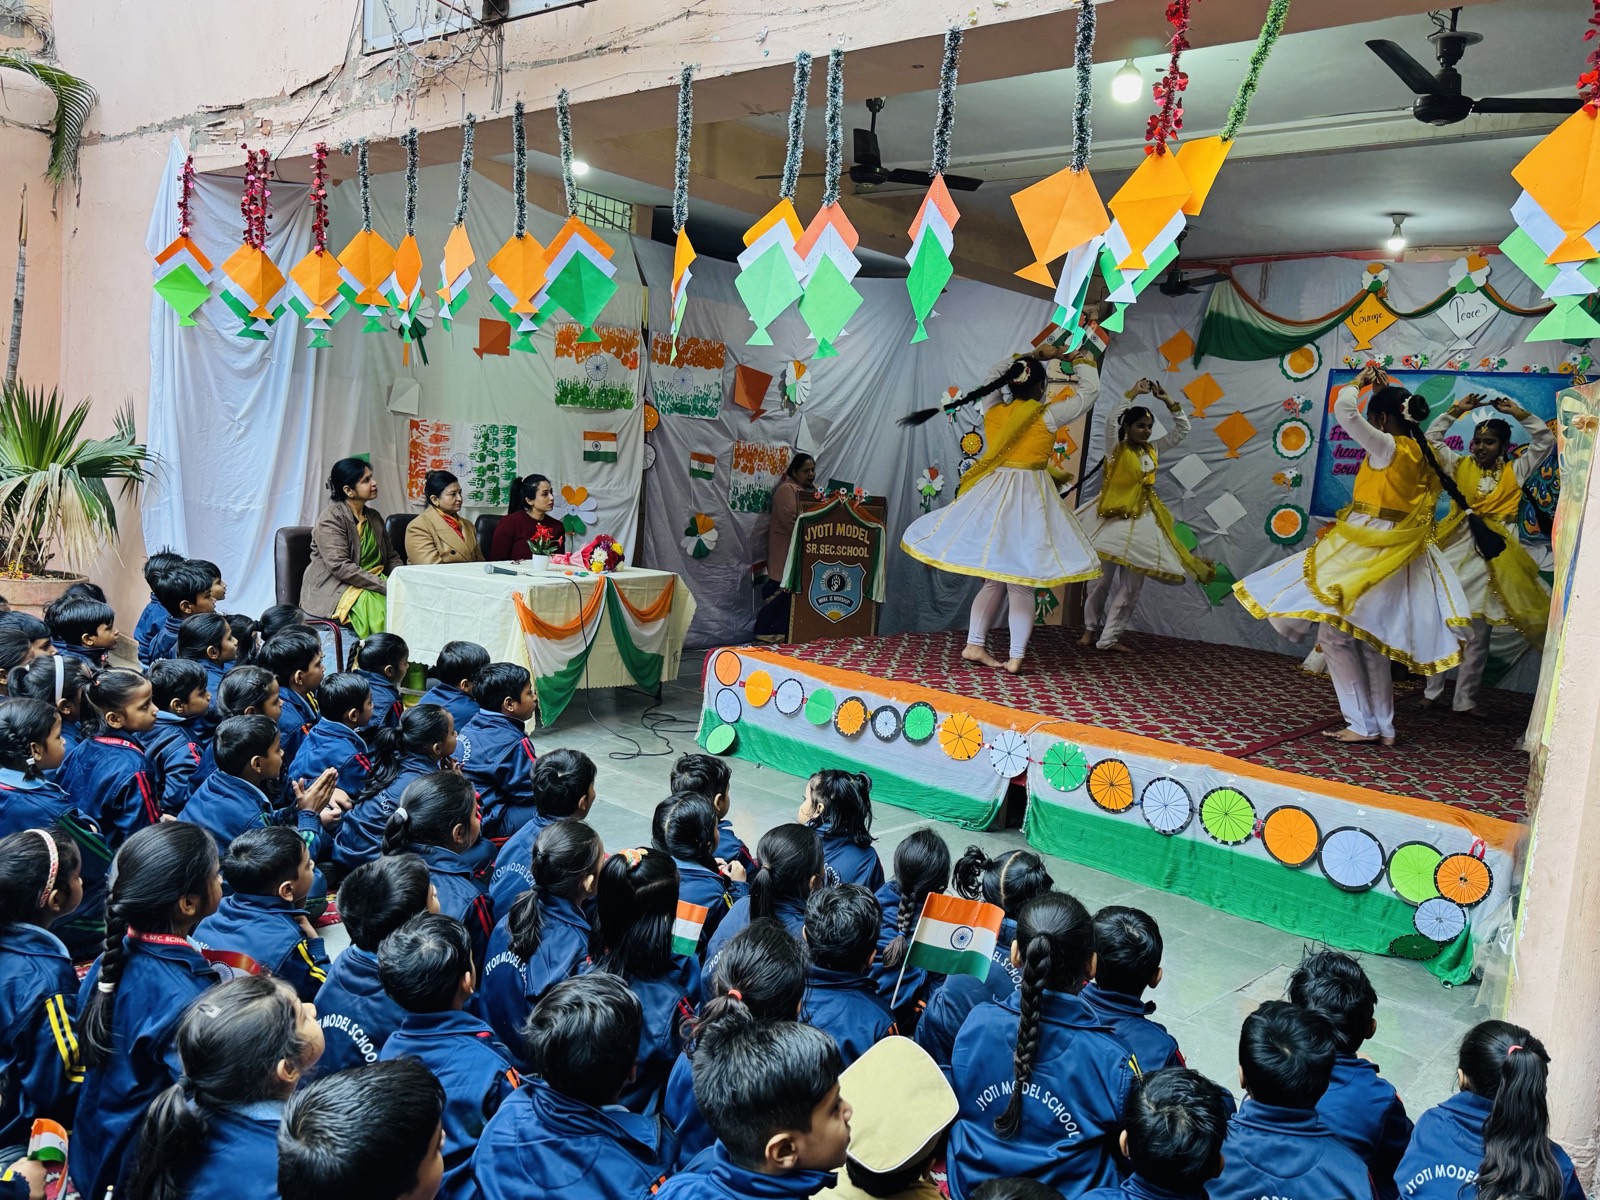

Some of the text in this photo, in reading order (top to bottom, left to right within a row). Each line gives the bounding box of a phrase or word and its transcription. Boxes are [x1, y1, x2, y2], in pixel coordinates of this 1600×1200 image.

[1448, 296, 1488, 324] Peace
[804, 523, 871, 545] JYOTI MODEL
[708, 950, 723, 973] JYOT
[322, 1013, 352, 1032] MODEL
[975, 1084, 1001, 1112] JYOTI
[1041, 1091, 1080, 1139] SCHOOL
[1405, 1167, 1433, 1195] JYOTI
